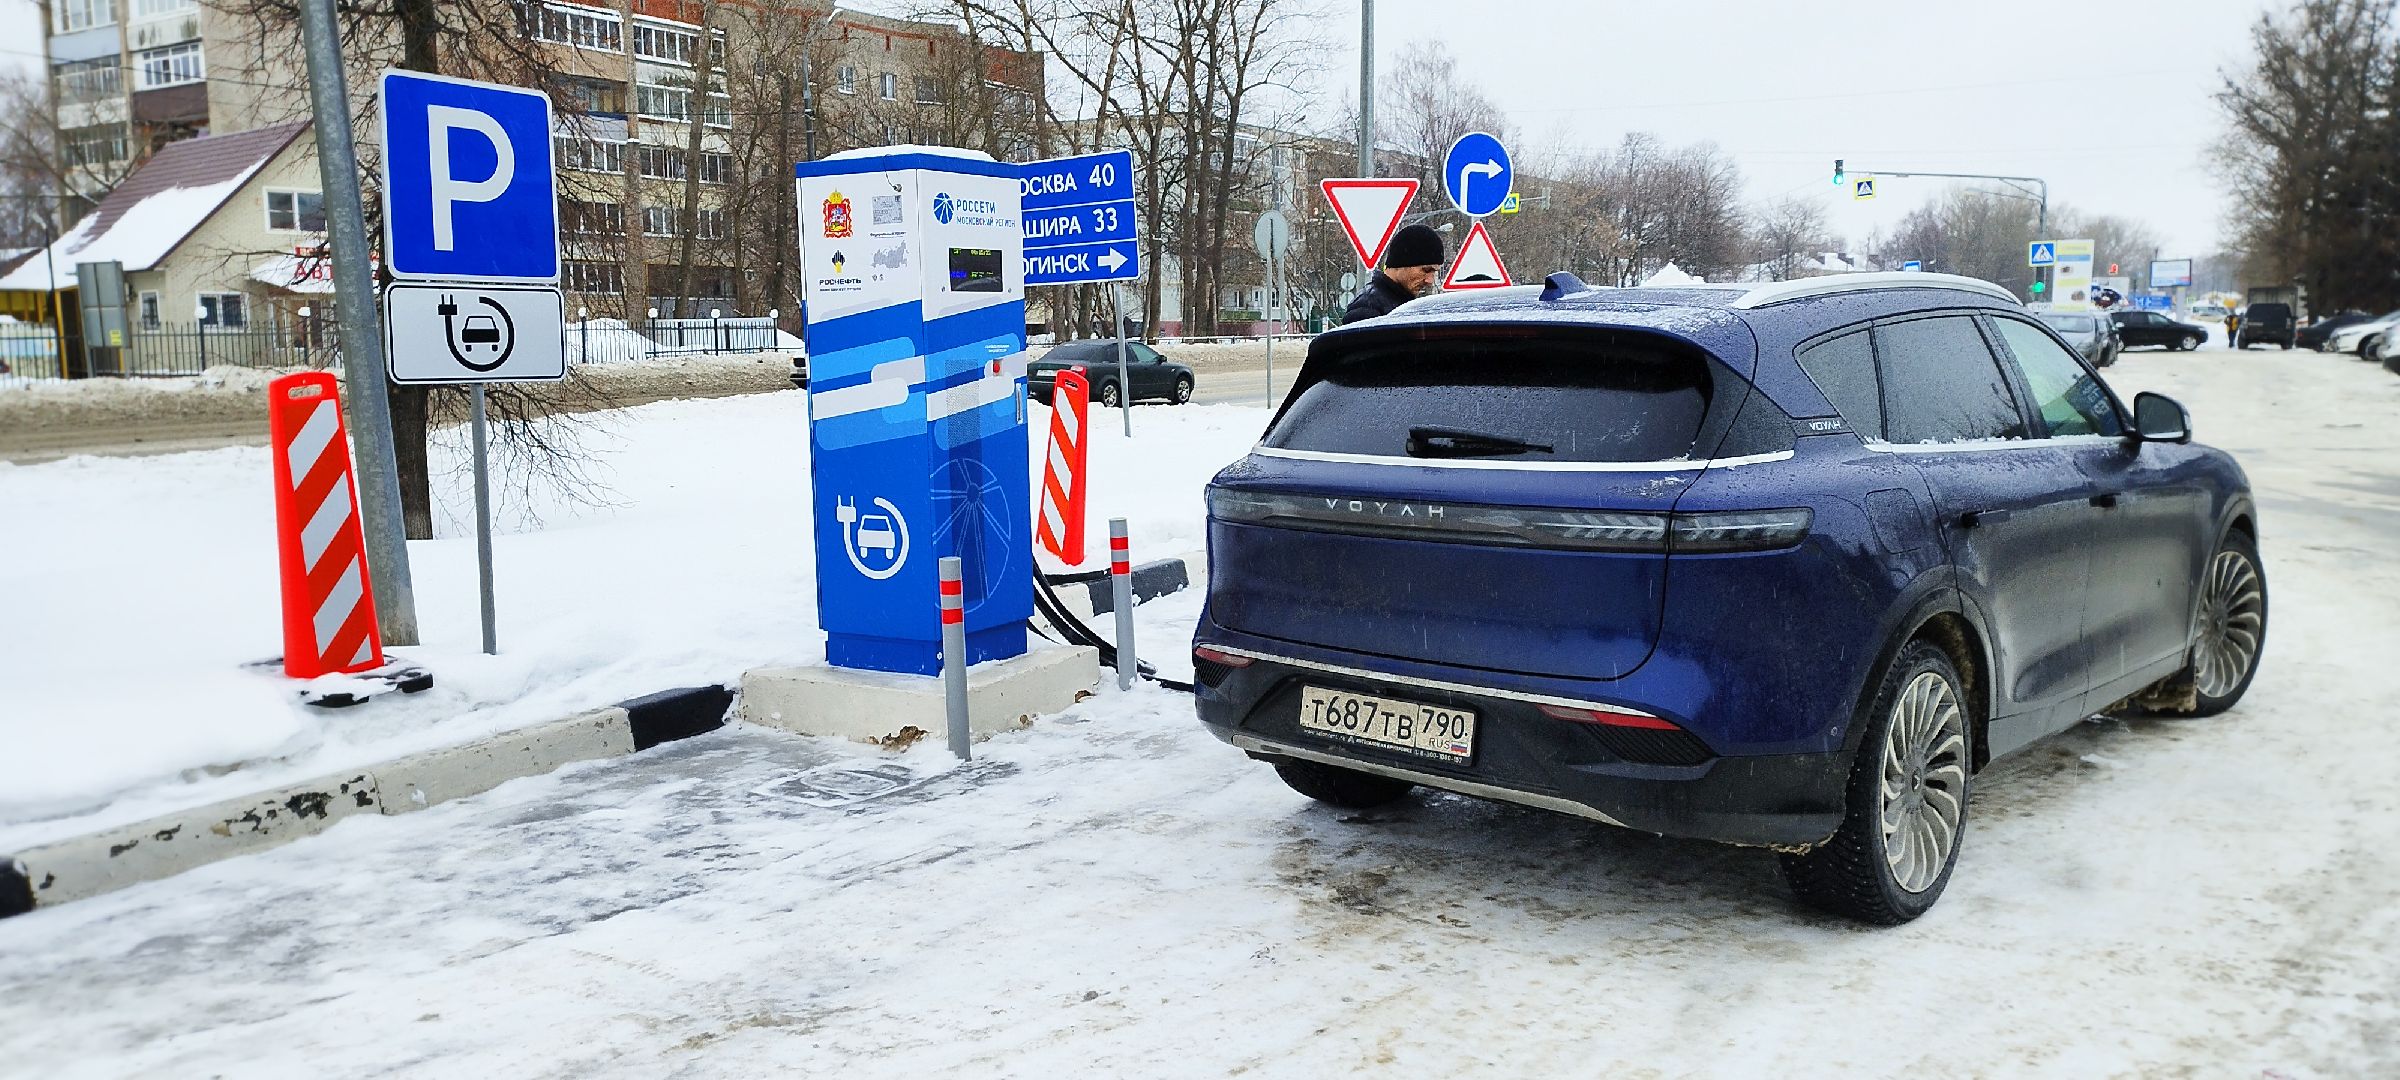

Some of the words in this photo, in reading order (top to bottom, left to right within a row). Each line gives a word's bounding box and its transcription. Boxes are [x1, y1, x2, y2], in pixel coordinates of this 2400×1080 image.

[427, 104, 515, 251] P
[1089, 163, 1115, 188] 40
[956, 199, 996, 214] РОССЕТИ
[1092, 207, 1118, 232] 33
[1325, 498, 1444, 518] VOYAH
[1422, 709, 1465, 739] 790
[1429, 737, 1450, 750] RUS
